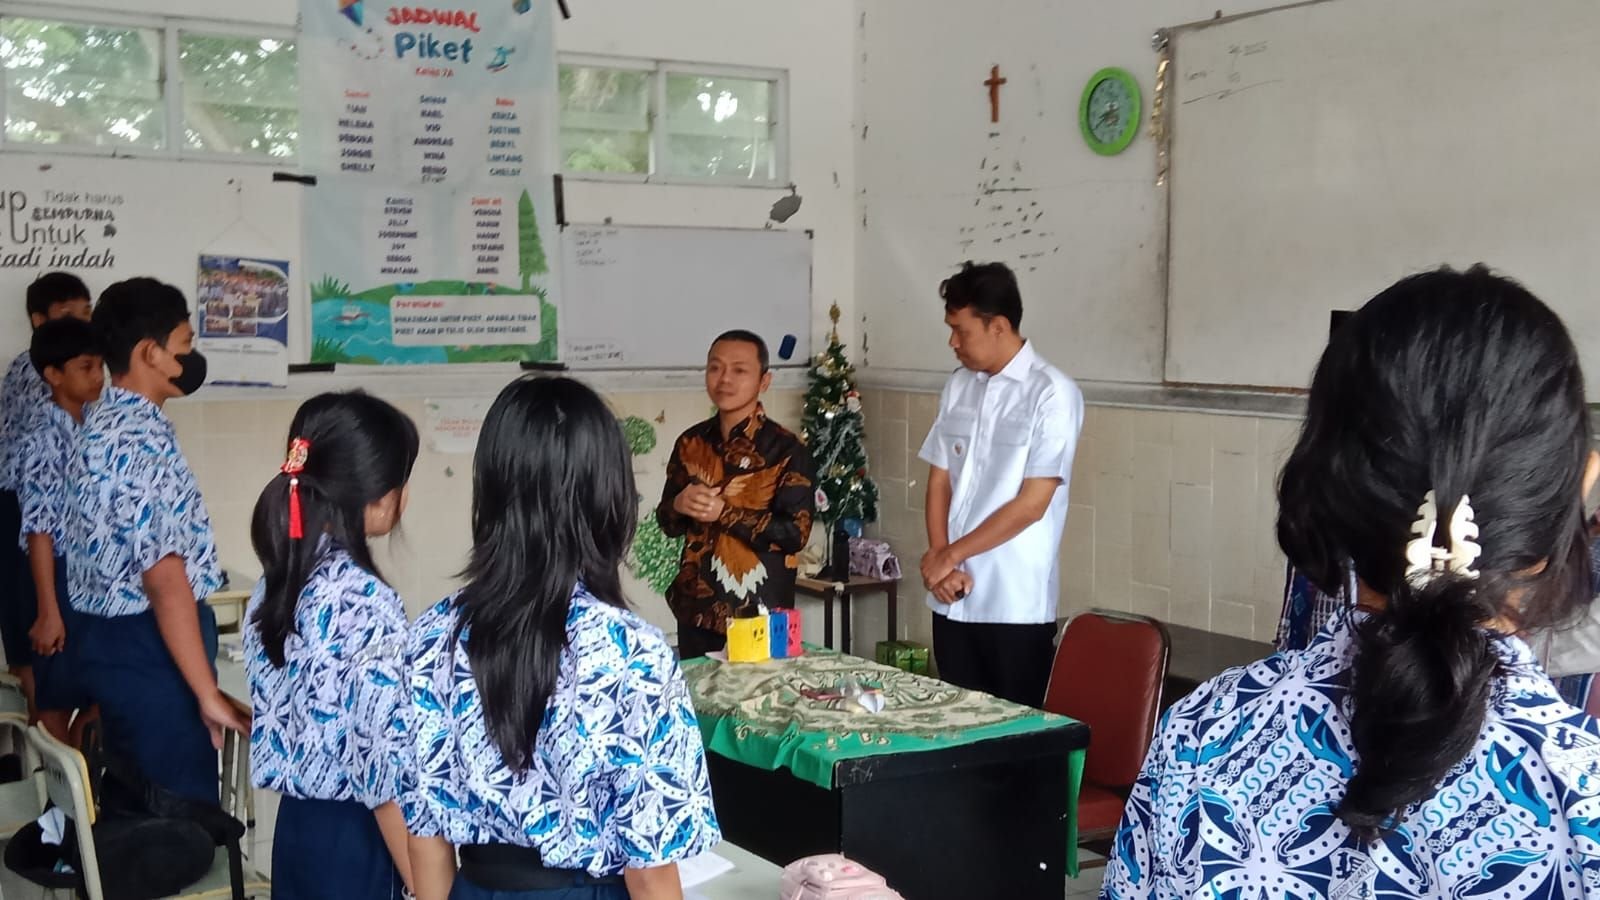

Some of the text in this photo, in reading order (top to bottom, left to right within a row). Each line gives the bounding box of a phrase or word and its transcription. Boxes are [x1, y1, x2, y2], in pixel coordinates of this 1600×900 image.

[386, 6, 480, 33] JADWAL
[394, 32, 473, 64] Piket
[44, 191, 123, 204] Tidak harus
[32, 207, 114, 221] SEMPURNA
[12, 222, 86, 244] Untuk
[48, 248, 115, 267] indah
